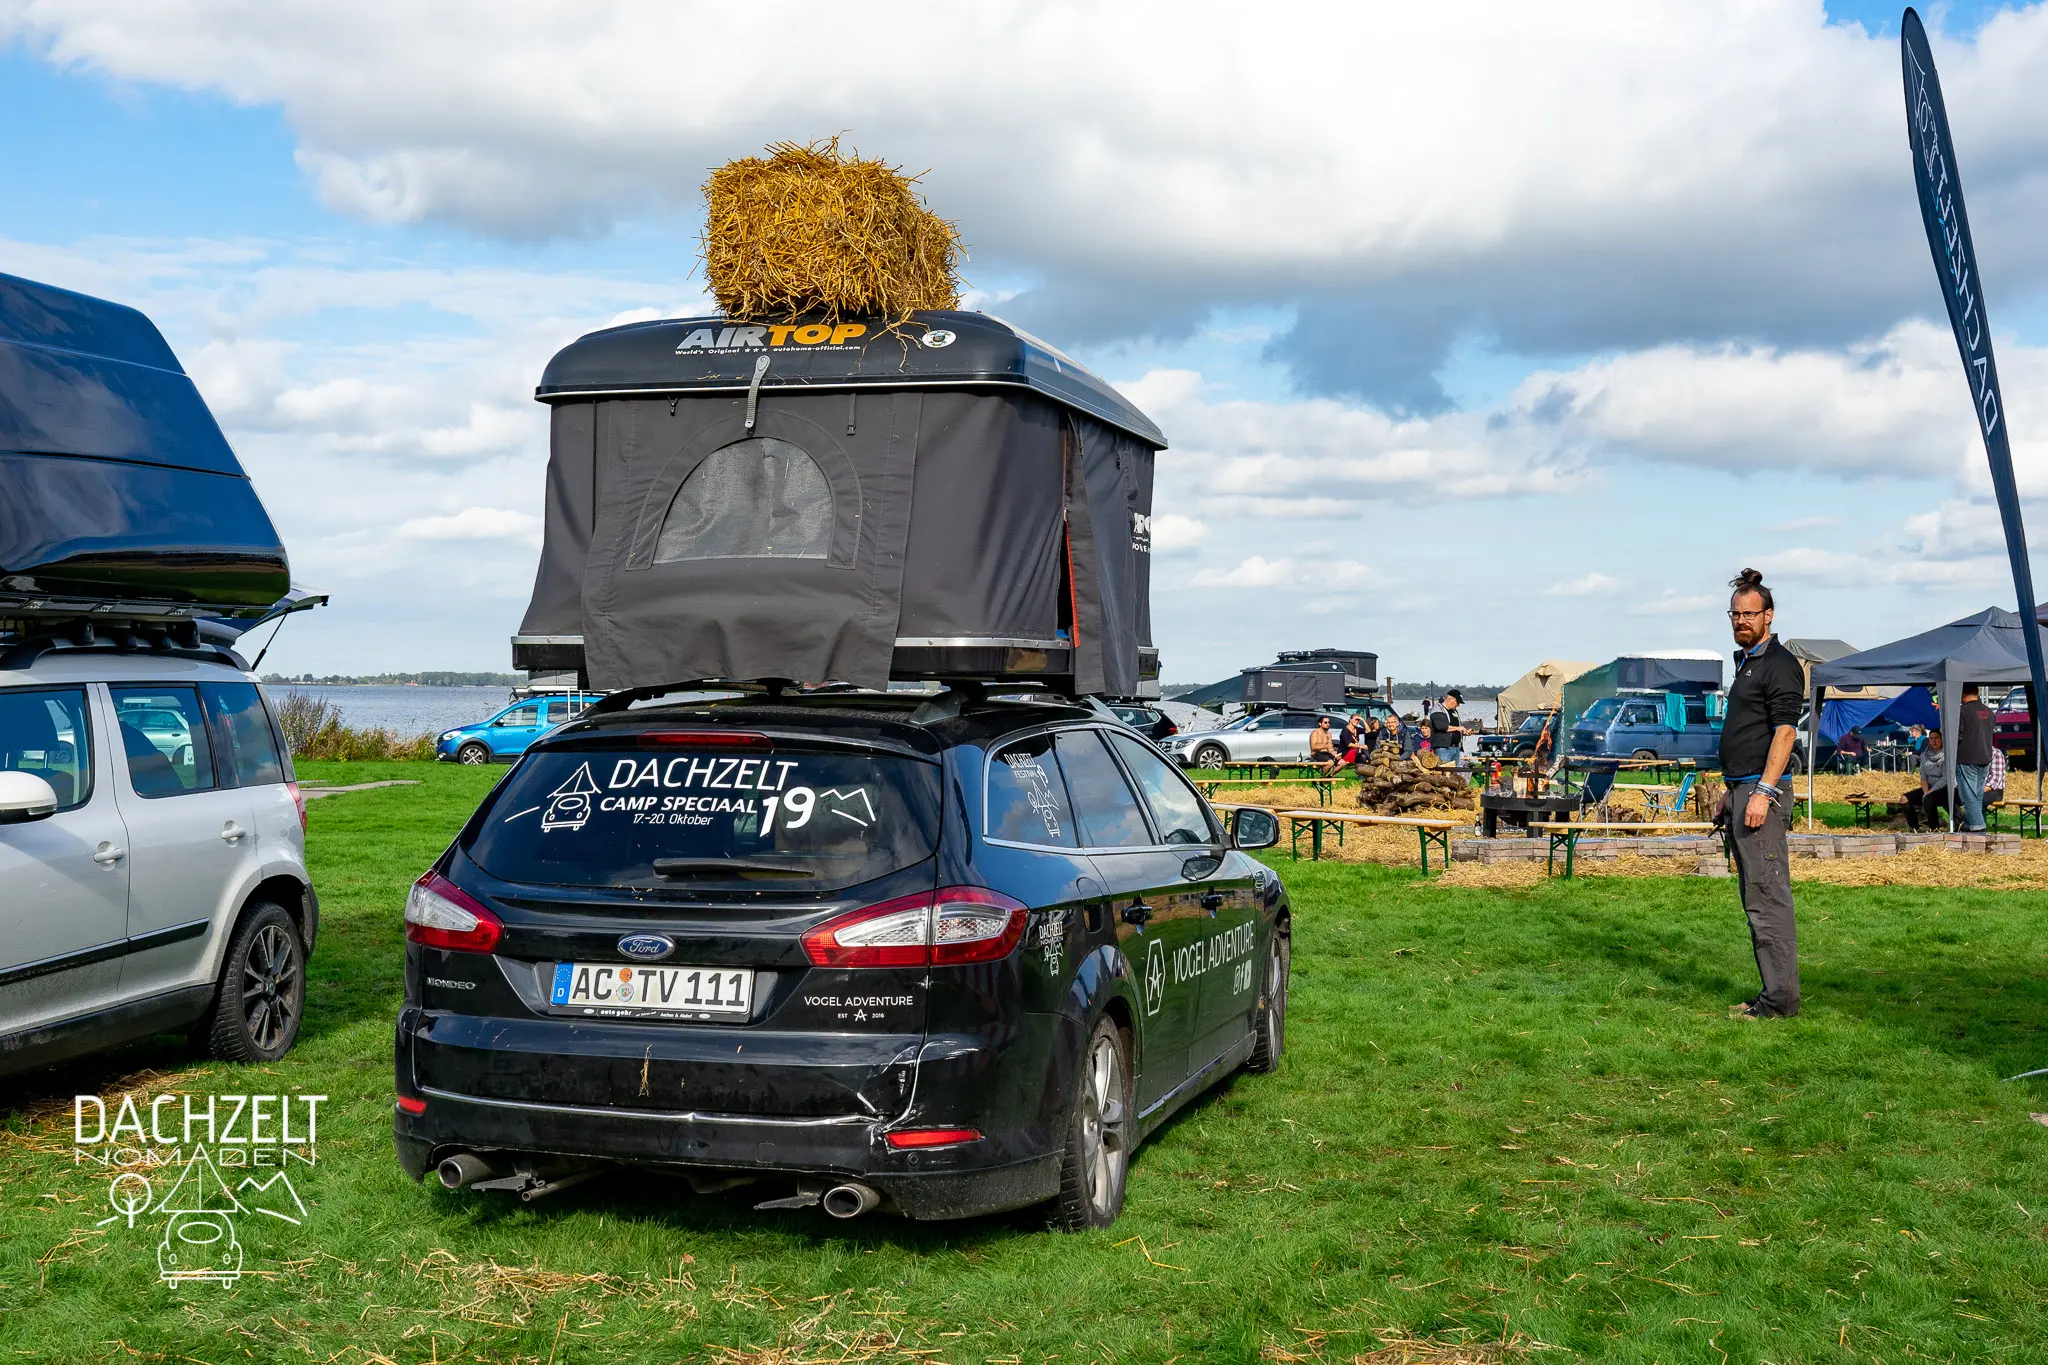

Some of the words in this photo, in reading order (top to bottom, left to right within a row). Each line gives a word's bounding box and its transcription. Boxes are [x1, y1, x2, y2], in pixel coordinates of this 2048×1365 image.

[676, 324, 867, 349] AIRTOP
[708, 347, 740, 355] Original
[1003, 753, 1037, 768] DACHZELT
[608, 757, 799, 791] DACHZELT
[600, 796, 658, 811] CAMP
[661, 796, 758, 813] SPECIAAL
[760, 786, 816, 837] 19
[633, 813, 665, 824] 17.-20.
[669, 813, 713, 825] Oktober
[629, 939, 660, 954] Ford
[1173, 940, 1206, 985] VOGEL
[1207, 920, 1254, 971] ADVENTURE
[557, 987, 565, 998] D
[572, 967, 613, 1000] AC
[638, 969, 679, 1003] TV
[684, 971, 746, 1007] 111
[804, 996, 842, 1006] VOGEL
[845, 995, 914, 1006] ADVENTURE
